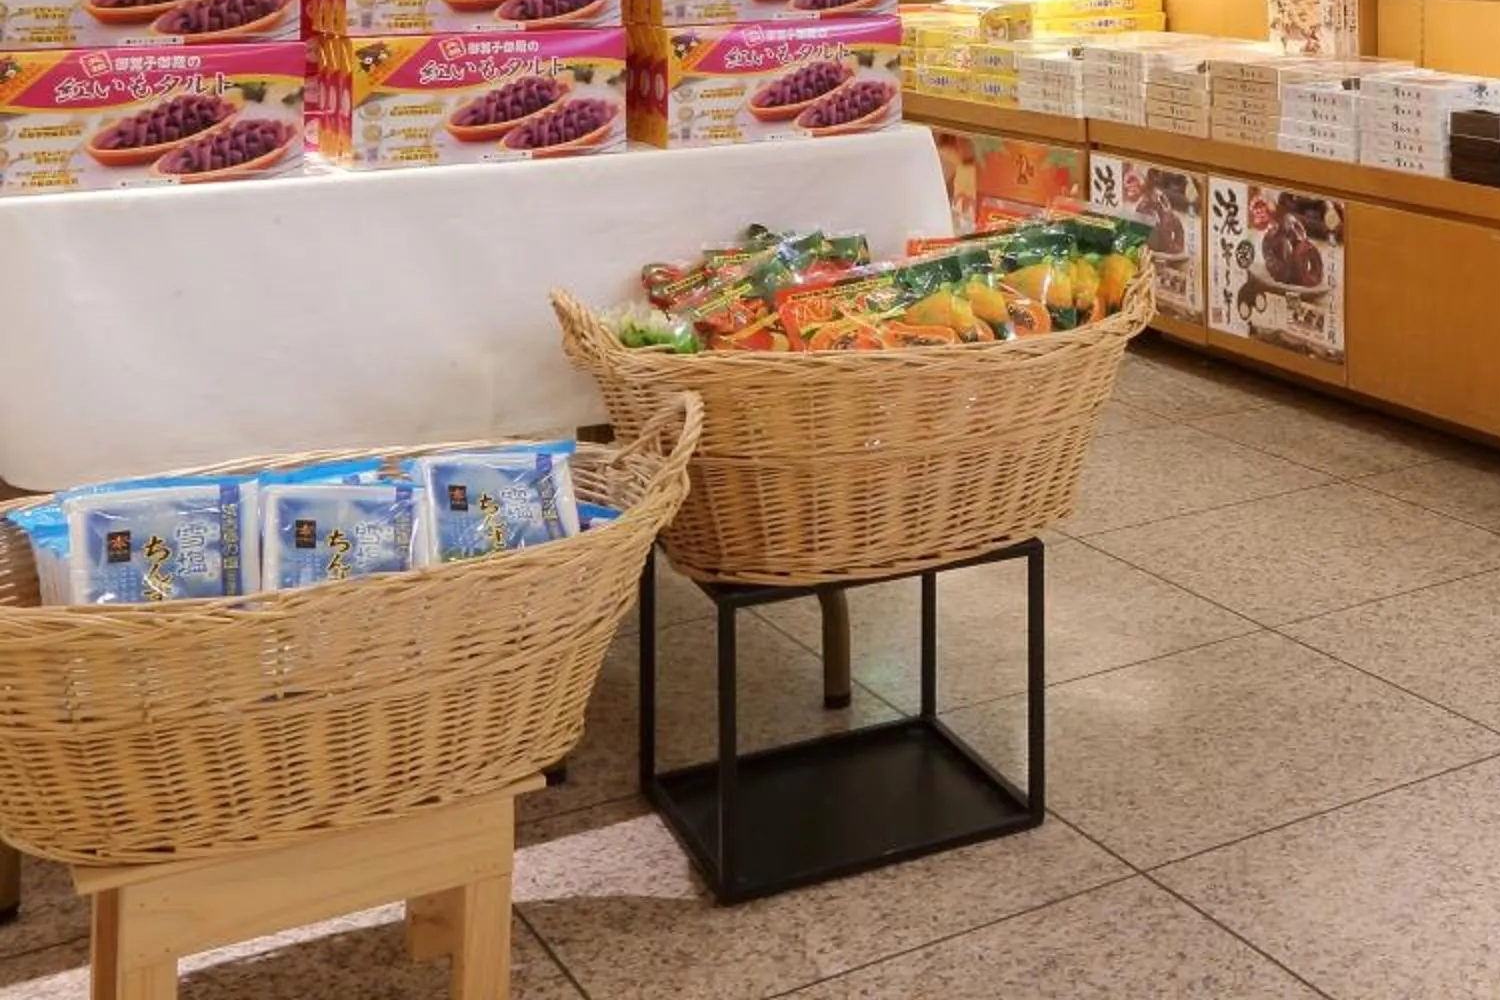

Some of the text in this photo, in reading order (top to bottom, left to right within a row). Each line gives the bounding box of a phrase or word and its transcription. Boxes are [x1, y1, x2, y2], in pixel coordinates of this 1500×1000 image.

[55, 72, 235, 102] 紅いもタルト
